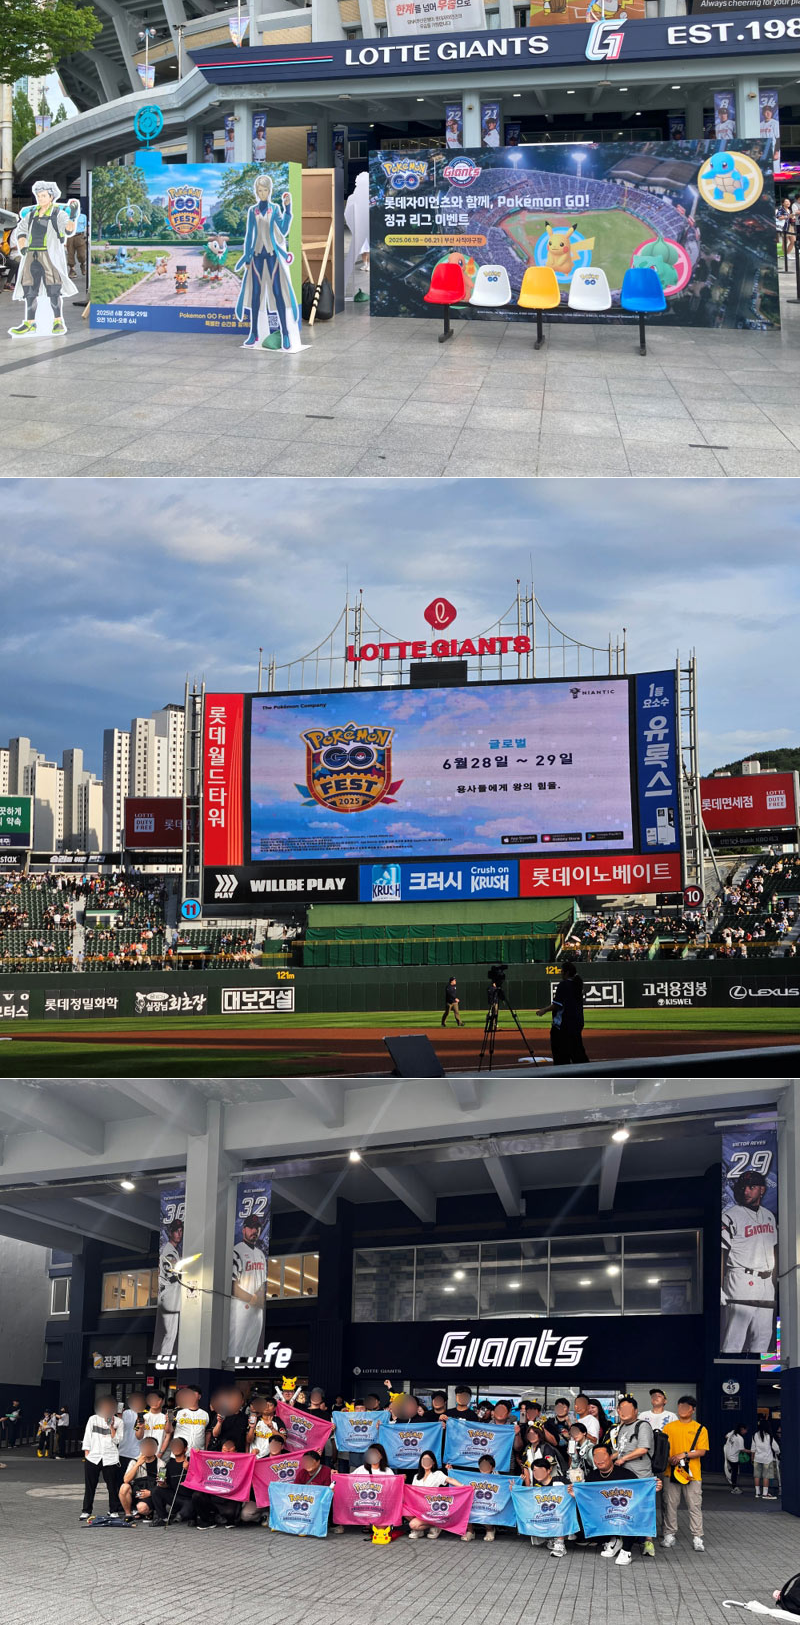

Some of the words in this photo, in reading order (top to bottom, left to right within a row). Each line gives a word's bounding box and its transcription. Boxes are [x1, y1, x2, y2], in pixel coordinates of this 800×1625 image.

[396, 3, 422, 16] 한계를
[423, 2, 437, 13] 넘어
[701, 0, 727, 8] Always
[728, 0, 761, 8] cheering
[773, 0, 790, 8] your
[345, 43, 431, 66] LOTTE
[437, 35, 549, 61] GIANTS
[720, 99, 730, 109] 8
[759, 97, 777, 108] 34
[484, 110, 498, 120] 21
[381, 158, 428, 177] Pokémon
[443, 165, 482, 177] Giants
[391, 175, 420, 190] GO
[167, 185, 202, 199] Pokémon
[174, 197, 196, 210] GO
[384, 195, 463, 210] 롯데자이언츠와
[465, 195, 494, 211] 함께,
[497, 194, 561, 207] Pokémon
[565, 194, 590, 207] GO!
[173, 215, 197, 224] FEST
[384, 213, 407, 227] 정규
[409, 213, 433, 227] 리그
[435, 213, 470, 226] 이벤트
[347, 640, 426, 662] LOTTE
[431, 635, 531, 658] GIANTS
[648, 683, 664, 697] 1등
[300, 702, 327, 710] Company
[642, 697, 670, 709] 요소수
[300, 721, 395, 749] Pokémon
[488, 737, 527, 750] 글로벌
[322, 745, 380, 770] GO
[535, 752, 574, 767] 29일
[643, 715, 673, 798] 유록스
[207, 705, 228, 828] 롯데월드타워
[319, 777, 380, 796] FEST
[338, 797, 360, 806] 2025
[701, 795, 753, 811] 롯데면세점
[470, 866, 495, 874] Crush
[531, 861, 673, 888] 롯데이노베이트
[250, 878, 304, 893] WILLBE
[306, 877, 346, 892] PLAY
[408, 870, 462, 891] 크러시
[470, 874, 509, 892] KRUSH
[372, 883, 400, 898] KRUSH
[686, 890, 700, 902] 10
[184, 903, 197, 916] 11
[276, 971, 295, 980] 121m
[642, 981, 708, 997] 고려용접봉
[748, 988, 800, 997] LEXUS
[44, 996, 119, 1012] 롯데정밀화학
[223, 988, 293, 1011] 대보건설
[727, 1149, 773, 1178] 29
[239, 1196, 268, 1219] 32
[744, 1222, 775, 1238] Giants
[436, 1329, 589, 1368] Giants
[103, 1355, 132, 1367] 짐캐리
[467, 1428, 494, 1440] Pokémon
[403, 1437, 418, 1447] GO
[472, 1436, 488, 1446] GO
[205, 1458, 235, 1471] Pokémon
[212, 1466, 229, 1476] GO
[352, 1481, 382, 1494] Pokémon
[600, 1486, 634, 1499] Pokémon
[287, 1493, 314, 1504] Pokémon
[359, 1490, 377, 1501] GO
[475, 1489, 493, 1500] GO
[292, 1501, 309, 1511] GO
[432, 1502, 448, 1512] GO
[541, 1502, 556, 1513] GO
[610, 1496, 627, 1507] GO
